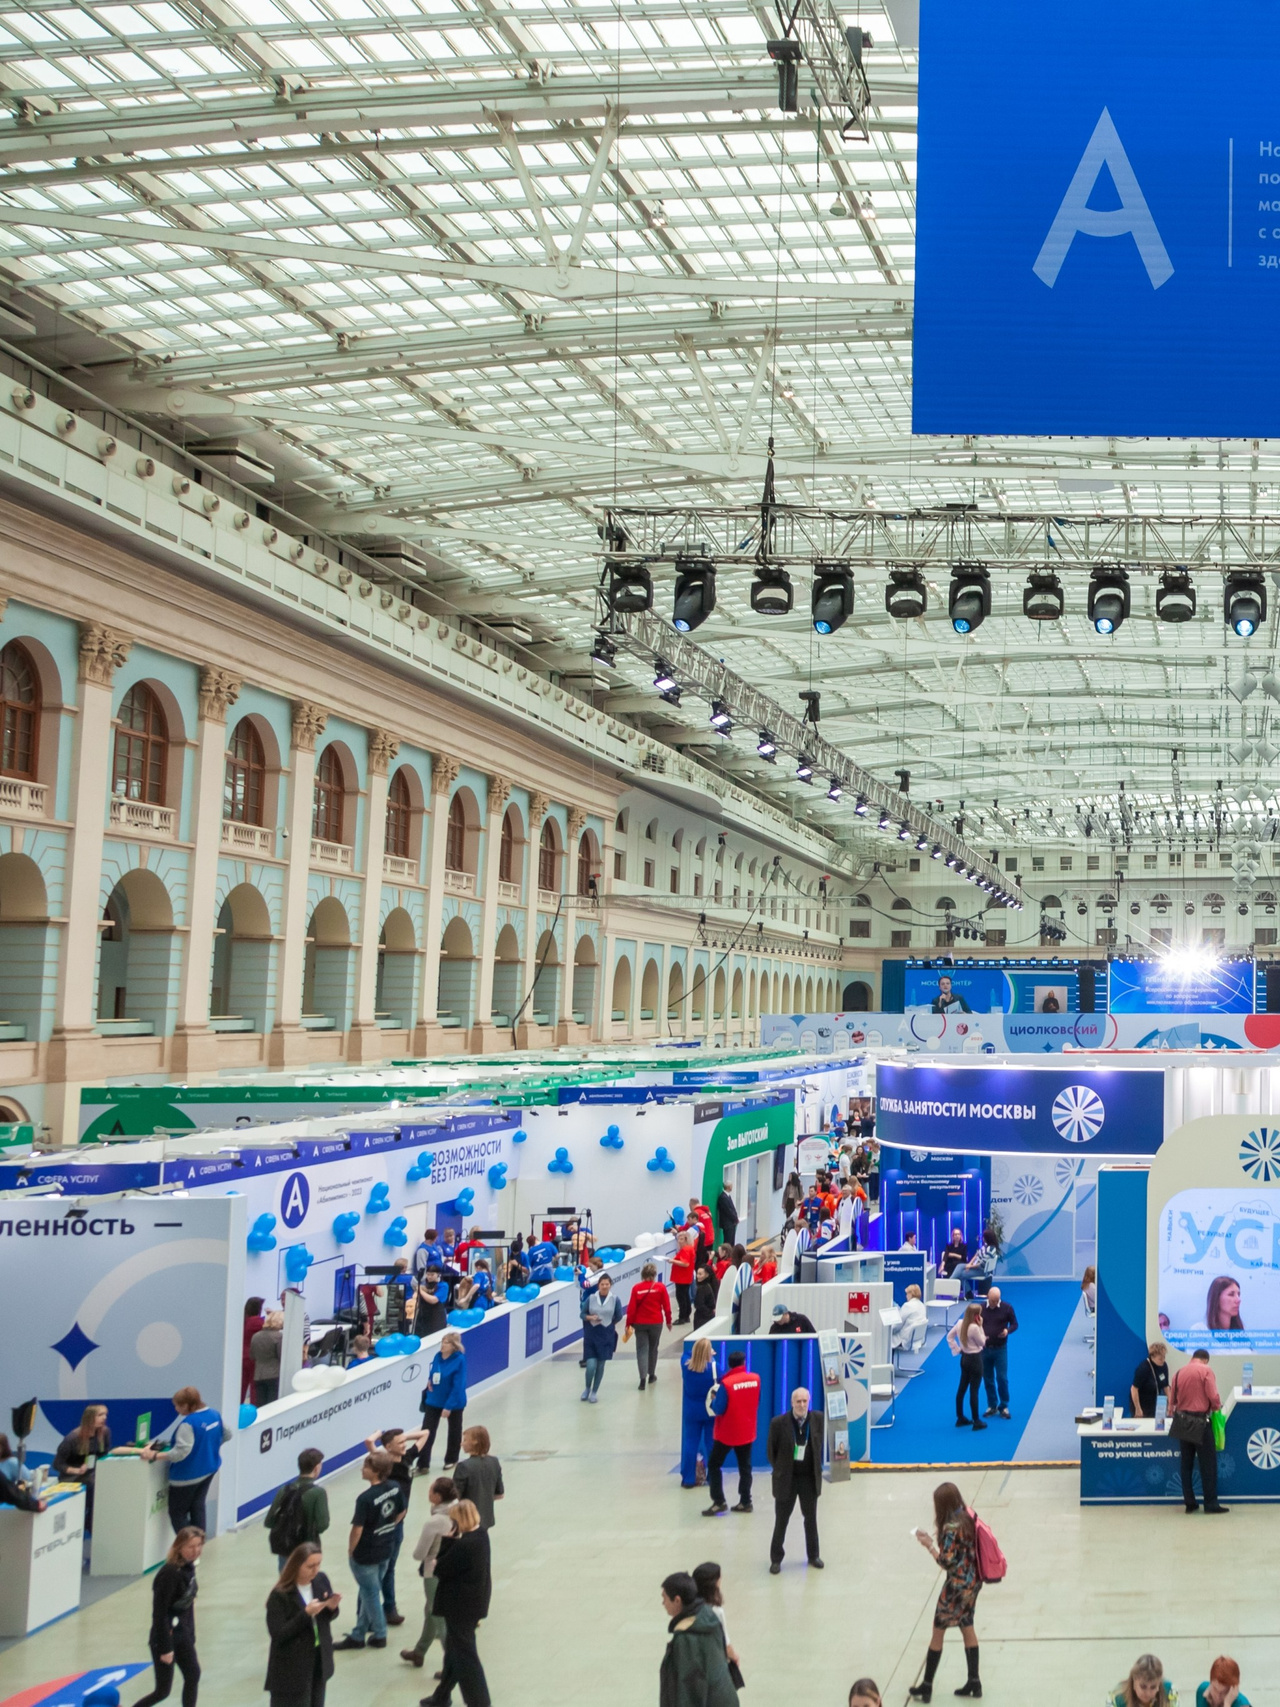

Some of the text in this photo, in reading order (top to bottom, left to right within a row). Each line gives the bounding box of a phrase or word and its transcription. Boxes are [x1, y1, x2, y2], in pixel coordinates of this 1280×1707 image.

[1259, 173, 1280, 185] по
[1258, 227, 1267, 239] с
[1010, 1023, 1098, 1036] ЦИОЛКОВСКИЙ
[880, 1097, 1037, 1120] СЛУЖБА ЗАНЯТОСТИ МОСКВЫ
[727, 1122, 768, 1151] Зал ВЫГОТСКИЙ
[431, 1139, 502, 1168] ВОЗМОЖНОСТИ
[200, 1166, 216, 1176] СФЕРА
[431, 1159, 486, 1185] БЕЗ ГРАНИЦ!
[37, 1174, 69, 1184] СФЕРА
[70, 1174, 99, 1184] УСЛУГ
[1239, 1206, 1270, 1216] БУДУЩЕЕ
[1197, 1230, 1232, 1238] РЕЗУЛЬТАТ
[1164, 1331, 1188, 1339] Среди
[1214, 1331, 1274, 1339] востребованных
[276, 1379, 392, 1442] Парикмахерское искусство
[1091, 1440, 1142, 1449] Твой успех
[1115, 1451, 1142, 1459] успех
[1143, 1449, 1172, 1459] целой
[33, 1529, 82, 1559] STEPLIFE
